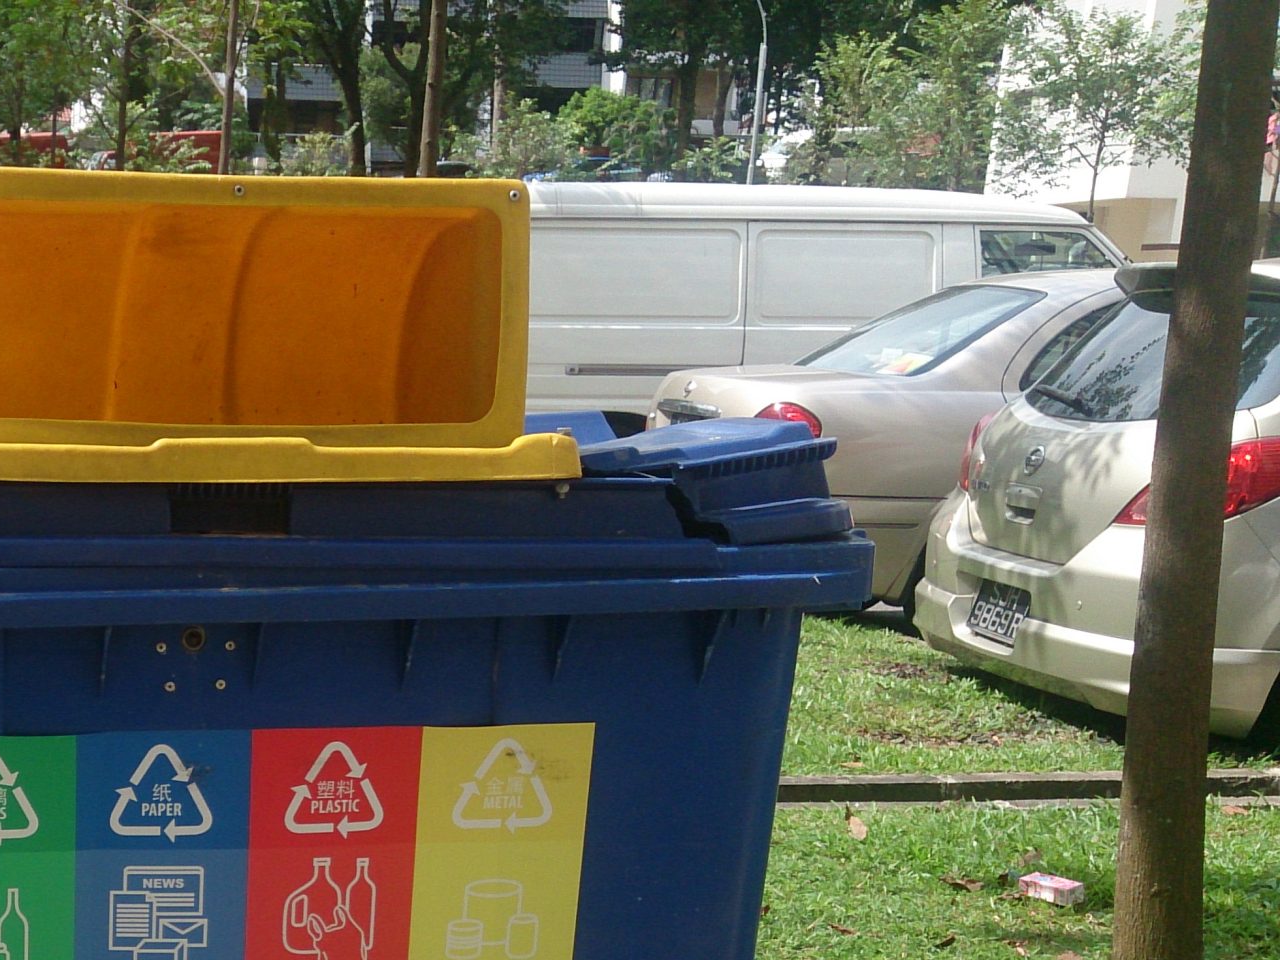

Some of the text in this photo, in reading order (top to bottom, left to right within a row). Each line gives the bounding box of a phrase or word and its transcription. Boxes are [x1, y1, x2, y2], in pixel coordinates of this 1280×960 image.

[970, 601, 1024, 639] 9869R
[152, 783, 171, 802] 纸
[316, 779, 354, 799] 塑料
[141, 802, 182, 817] PAPER
[311, 799, 360, 814] PLASTIC
[483, 796, 523, 809] METAL
[142, 878, 185, 889] NEWS
